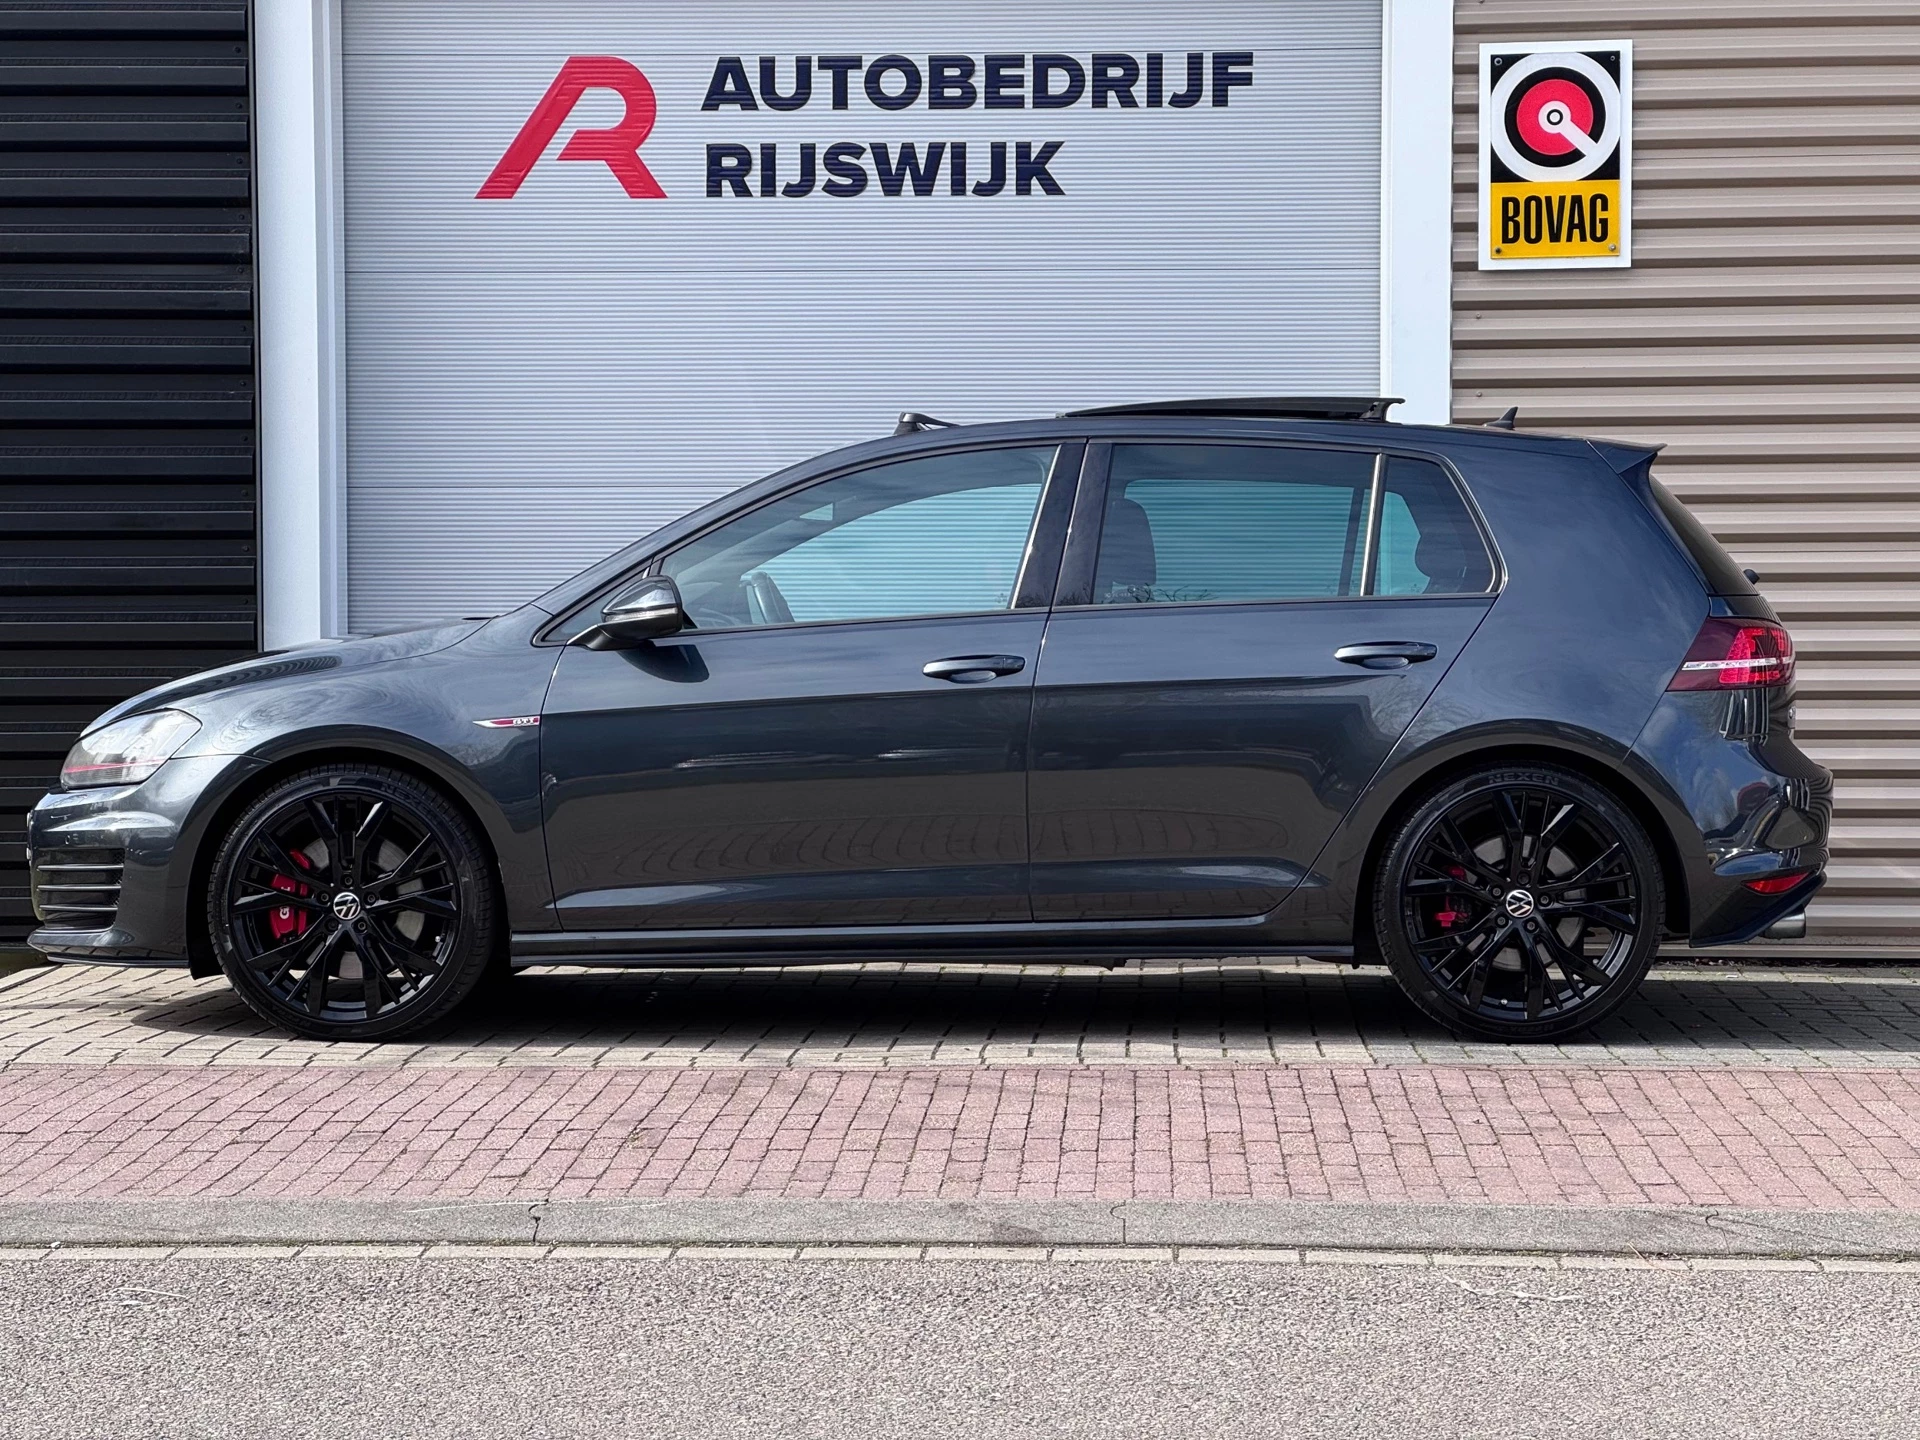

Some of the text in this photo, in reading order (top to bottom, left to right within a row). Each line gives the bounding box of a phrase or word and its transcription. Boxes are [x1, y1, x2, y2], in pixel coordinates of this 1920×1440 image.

[702, 51, 1254, 112] AUTOBEDRIJF
[706, 141, 1065, 198] RIJSWIJK
[1501, 193, 1610, 245] BOVAG
[1488, 772, 1560, 786] NEXEN
